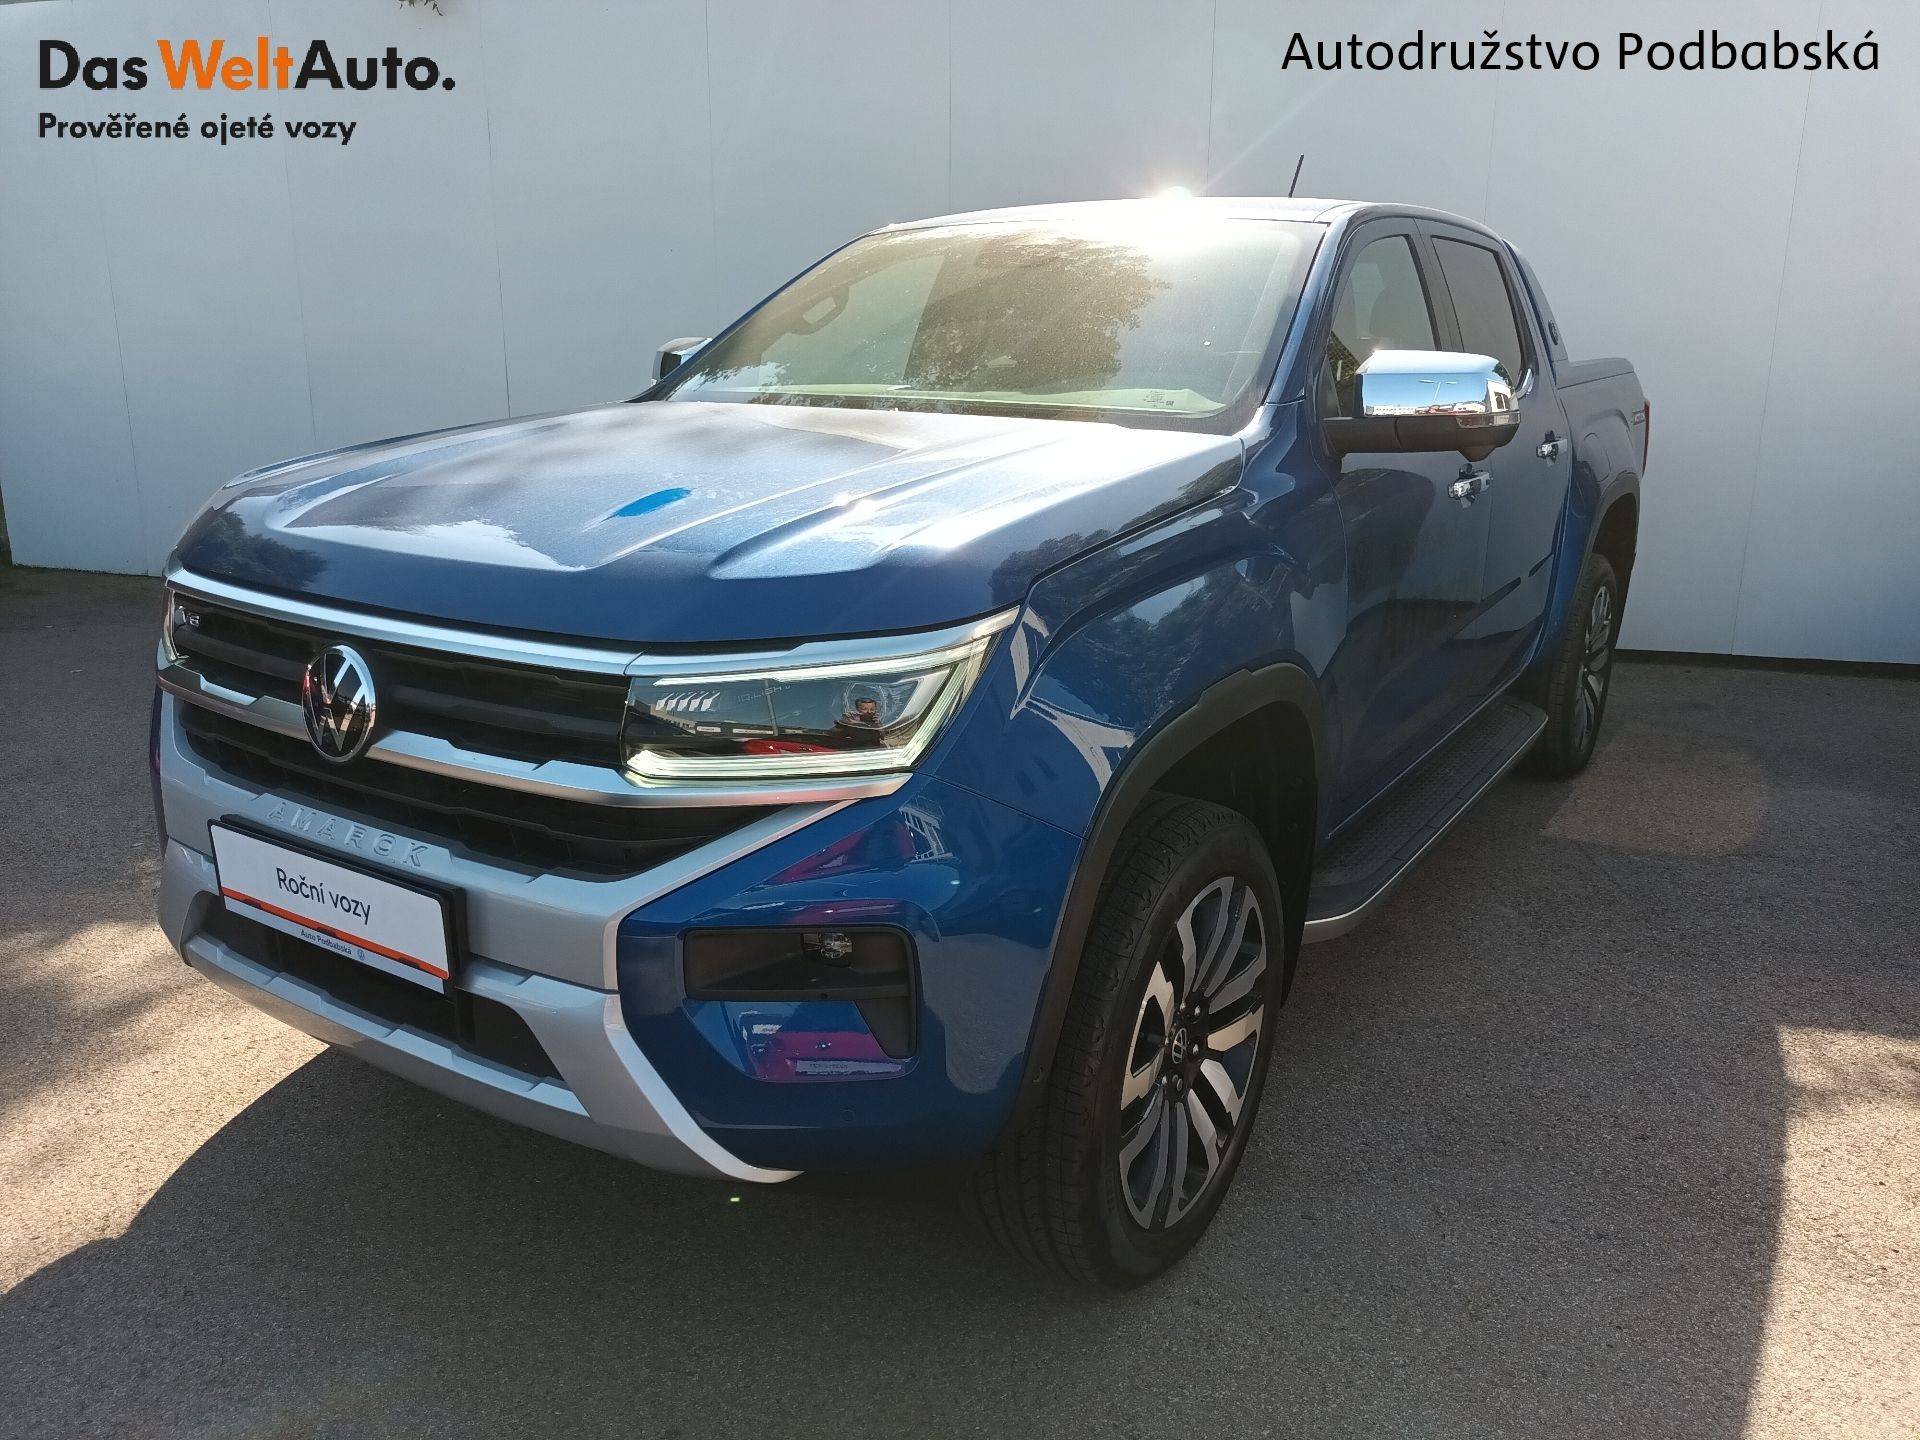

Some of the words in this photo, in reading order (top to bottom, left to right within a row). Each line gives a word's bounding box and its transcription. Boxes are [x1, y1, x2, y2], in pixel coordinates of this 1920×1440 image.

[266, 801, 428, 868] AMAROK
[276, 867, 325, 905] Roční
[328, 891, 371, 926] vozy
[301, 929, 316, 943] Auto
[316, 935, 352, 956] Podbabská
